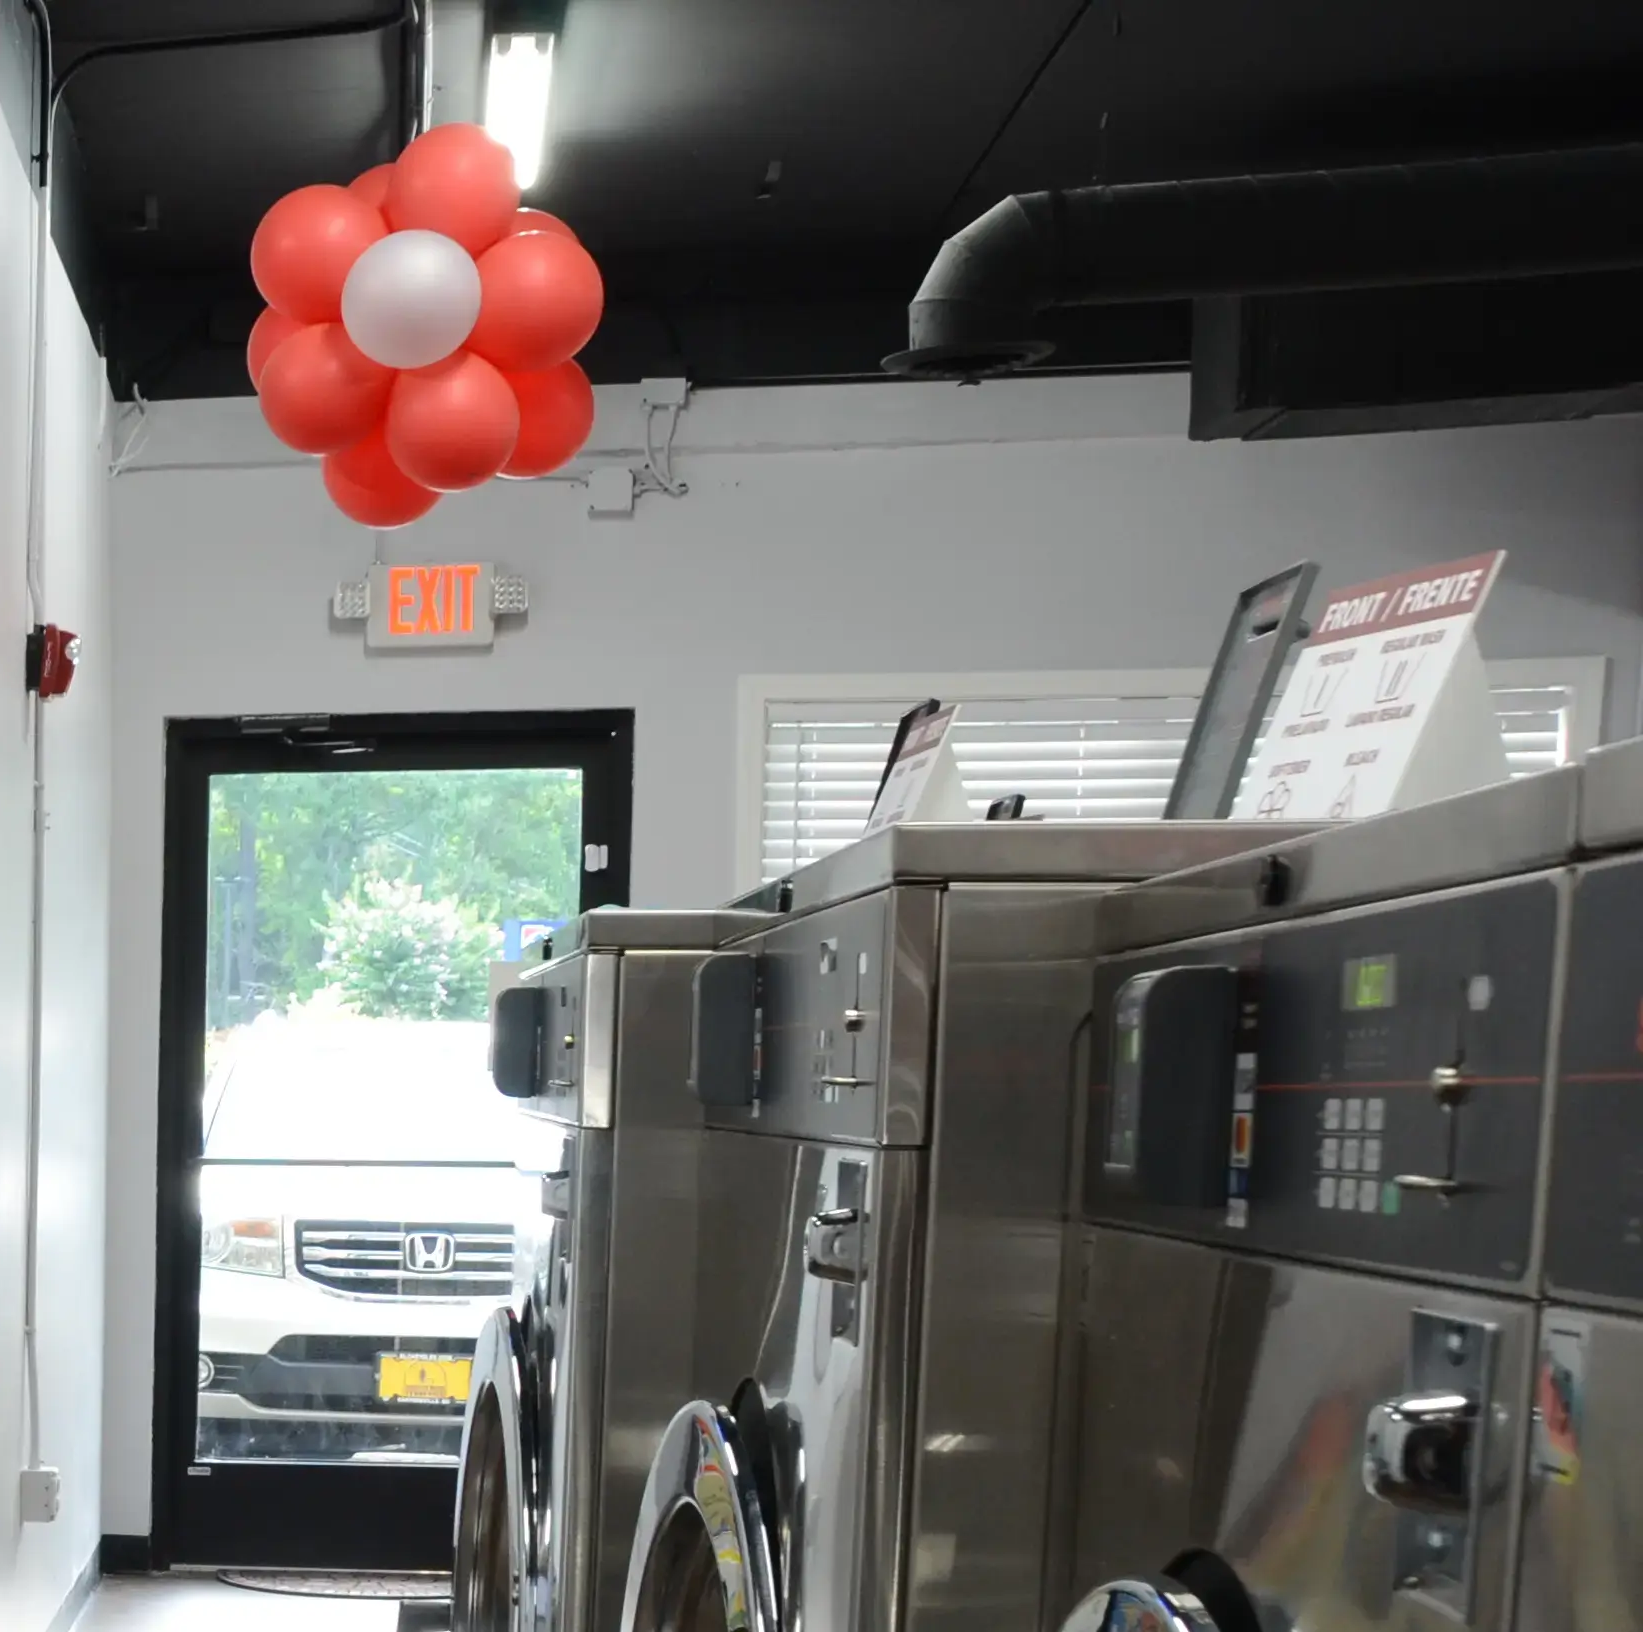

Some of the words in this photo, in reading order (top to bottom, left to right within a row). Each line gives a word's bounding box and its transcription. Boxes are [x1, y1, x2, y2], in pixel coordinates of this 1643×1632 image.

[388, 564, 480, 636] EXIT
[1317, 591, 1388, 633] FRONT
[1397, 568, 1484, 616] FRENTE
